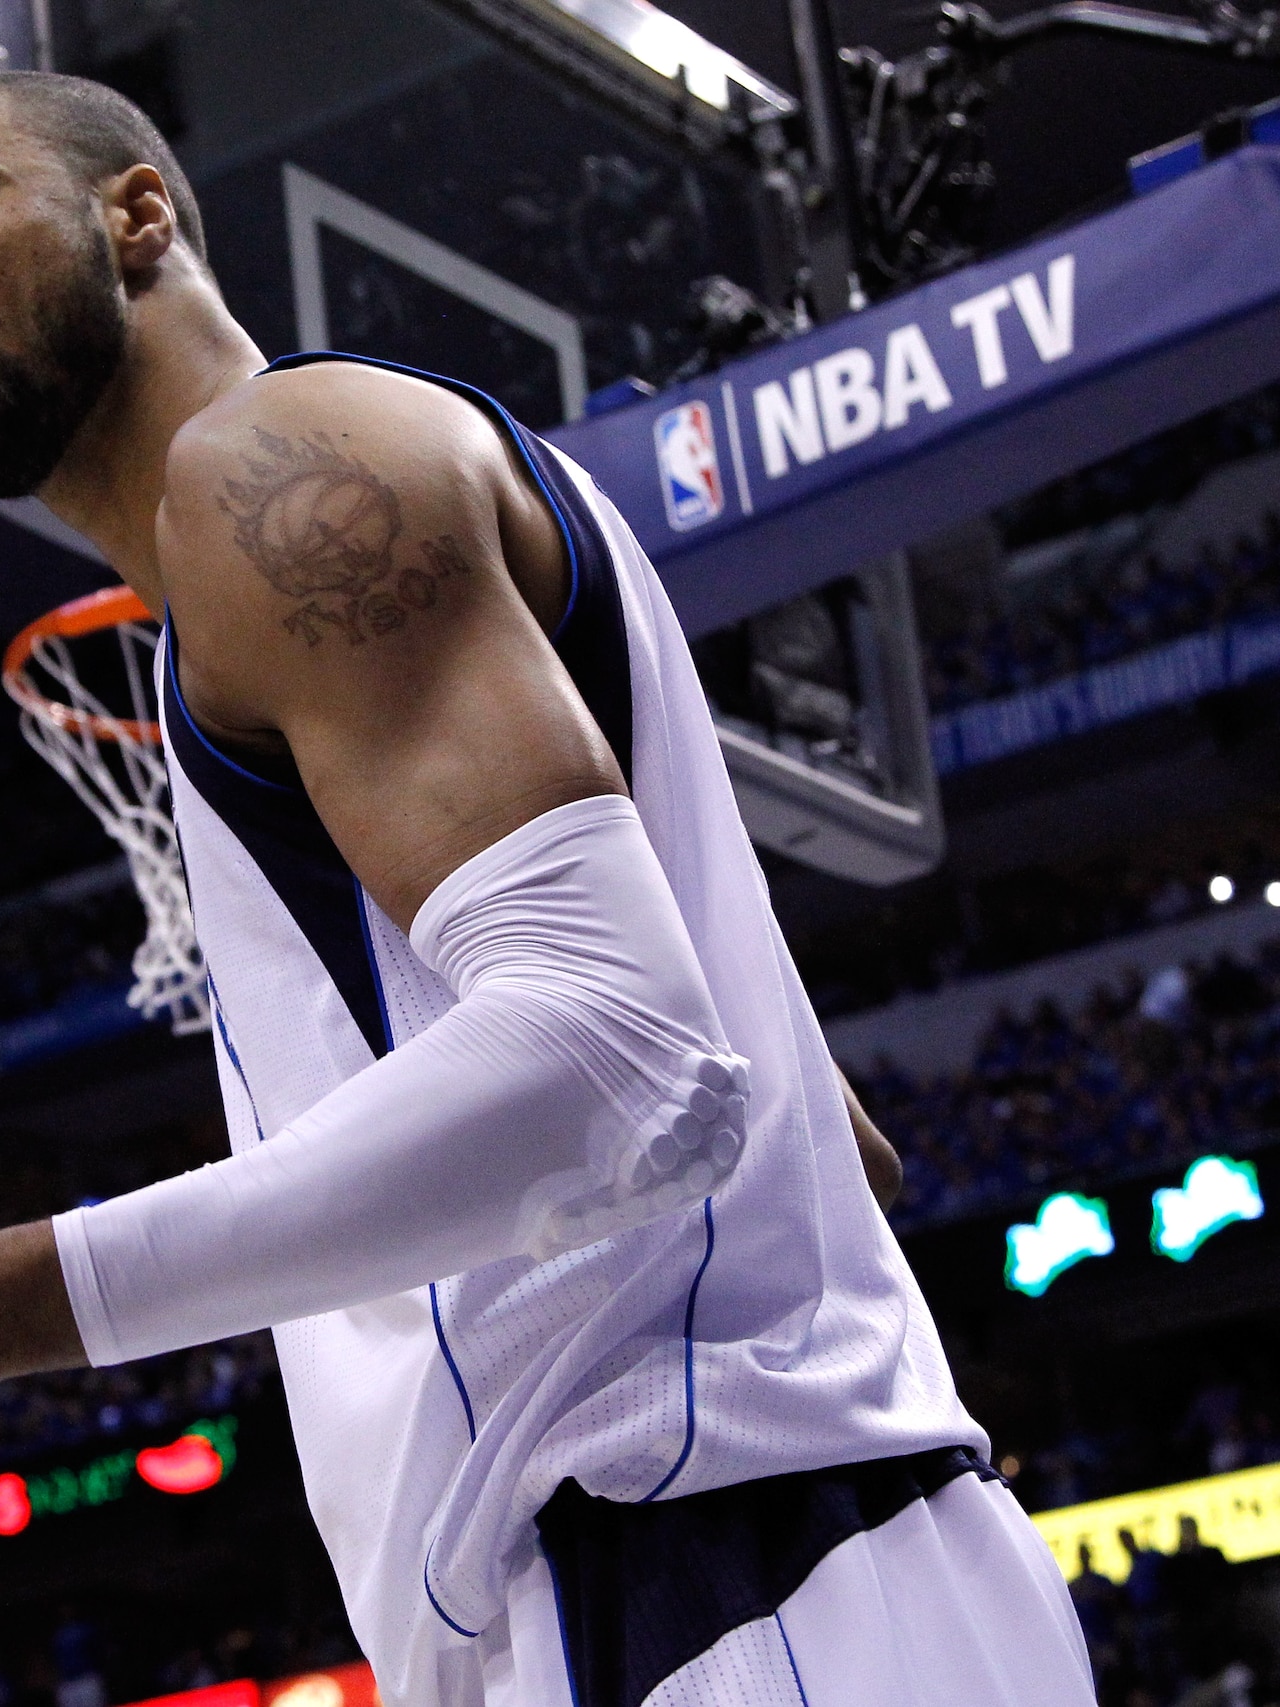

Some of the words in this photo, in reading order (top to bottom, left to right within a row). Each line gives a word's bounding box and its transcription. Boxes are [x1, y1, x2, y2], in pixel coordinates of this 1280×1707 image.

[753, 324, 952, 480] NBA
[952, 255, 1075, 390] TV
[284, 534, 470, 647] TYSON
